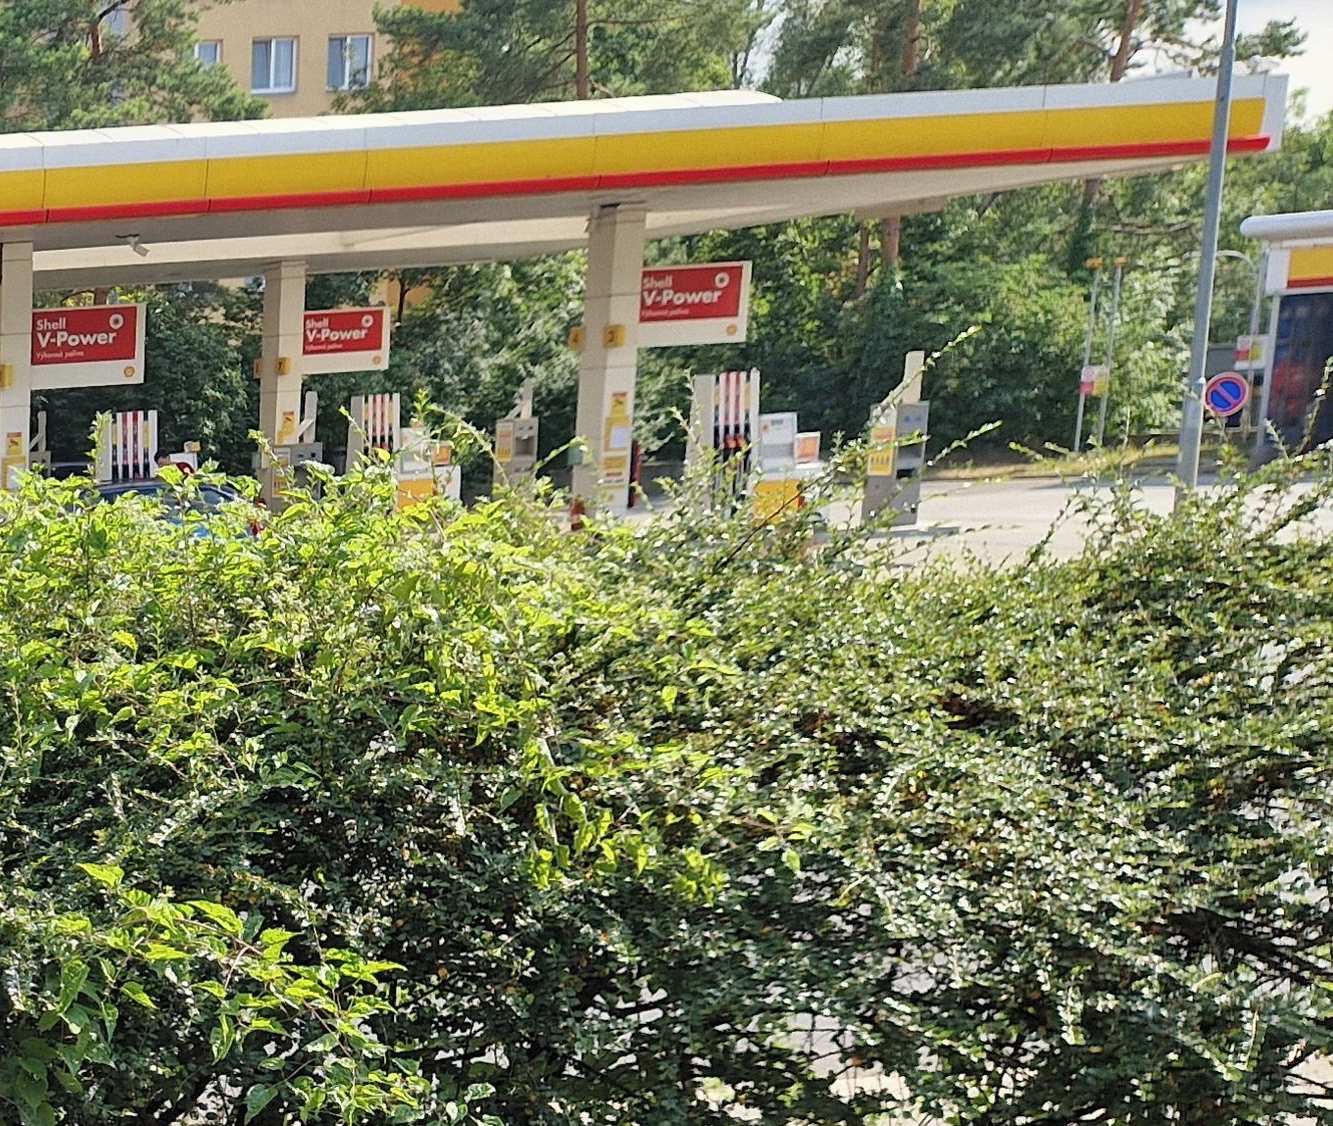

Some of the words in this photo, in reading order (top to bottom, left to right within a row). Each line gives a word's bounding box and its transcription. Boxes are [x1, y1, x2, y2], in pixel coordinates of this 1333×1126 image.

[642, 274, 673, 290] Shell
[643, 289, 723, 306] V-Power
[36, 317, 67, 331] Shell
[305, 317, 329, 329] Shell
[37, 331, 117, 348] V-Power
[306, 328, 369, 342] V-Power
